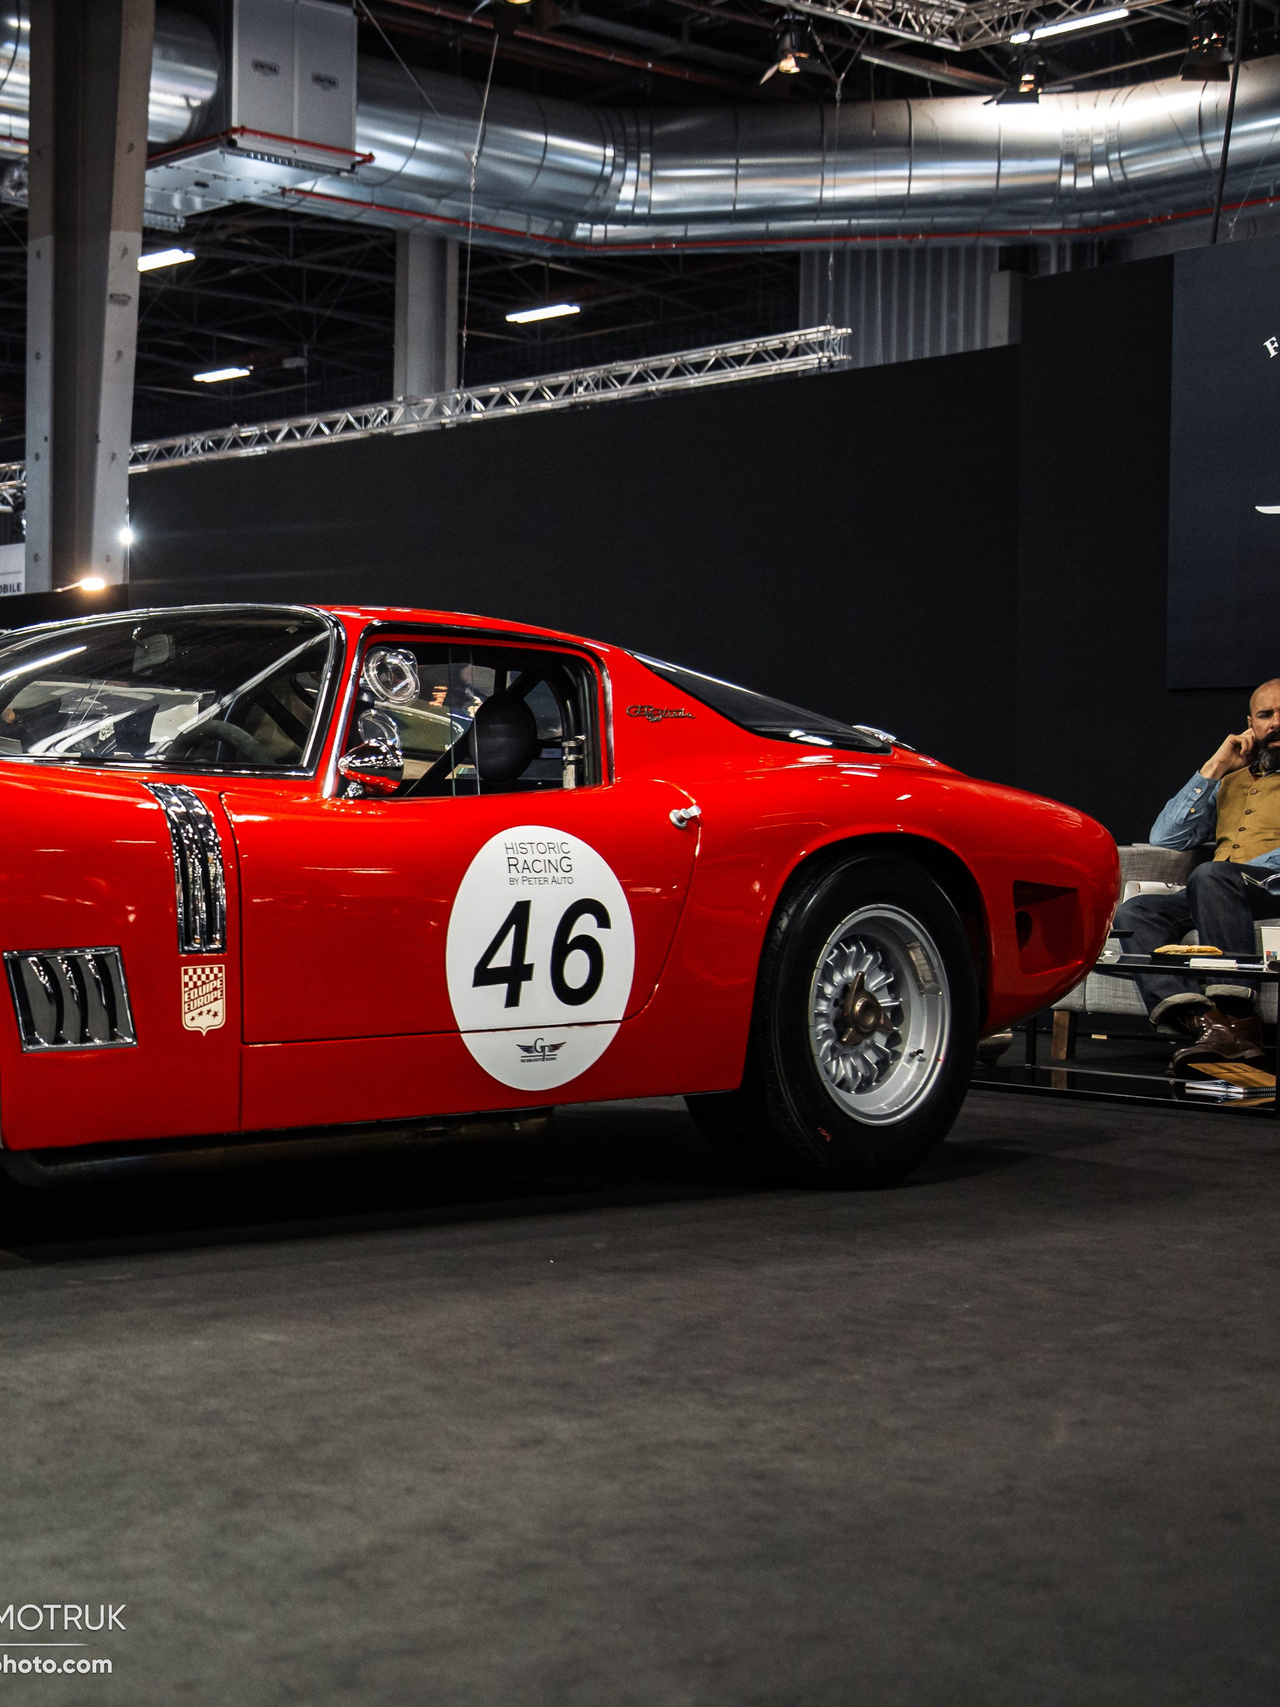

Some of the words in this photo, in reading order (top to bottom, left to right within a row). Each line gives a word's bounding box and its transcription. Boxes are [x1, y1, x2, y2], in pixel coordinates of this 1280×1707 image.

[504, 842, 571, 855] HISTORIC
[507, 856, 573, 875] RACING
[509, 877, 519, 885] BY
[521, 876, 549, 885] PETER
[550, 875, 574, 885] AUTO
[472, 897, 612, 1009] 46
[184, 977, 223, 1002] EQUIPE
[184, 988, 224, 1013] EUROPE
